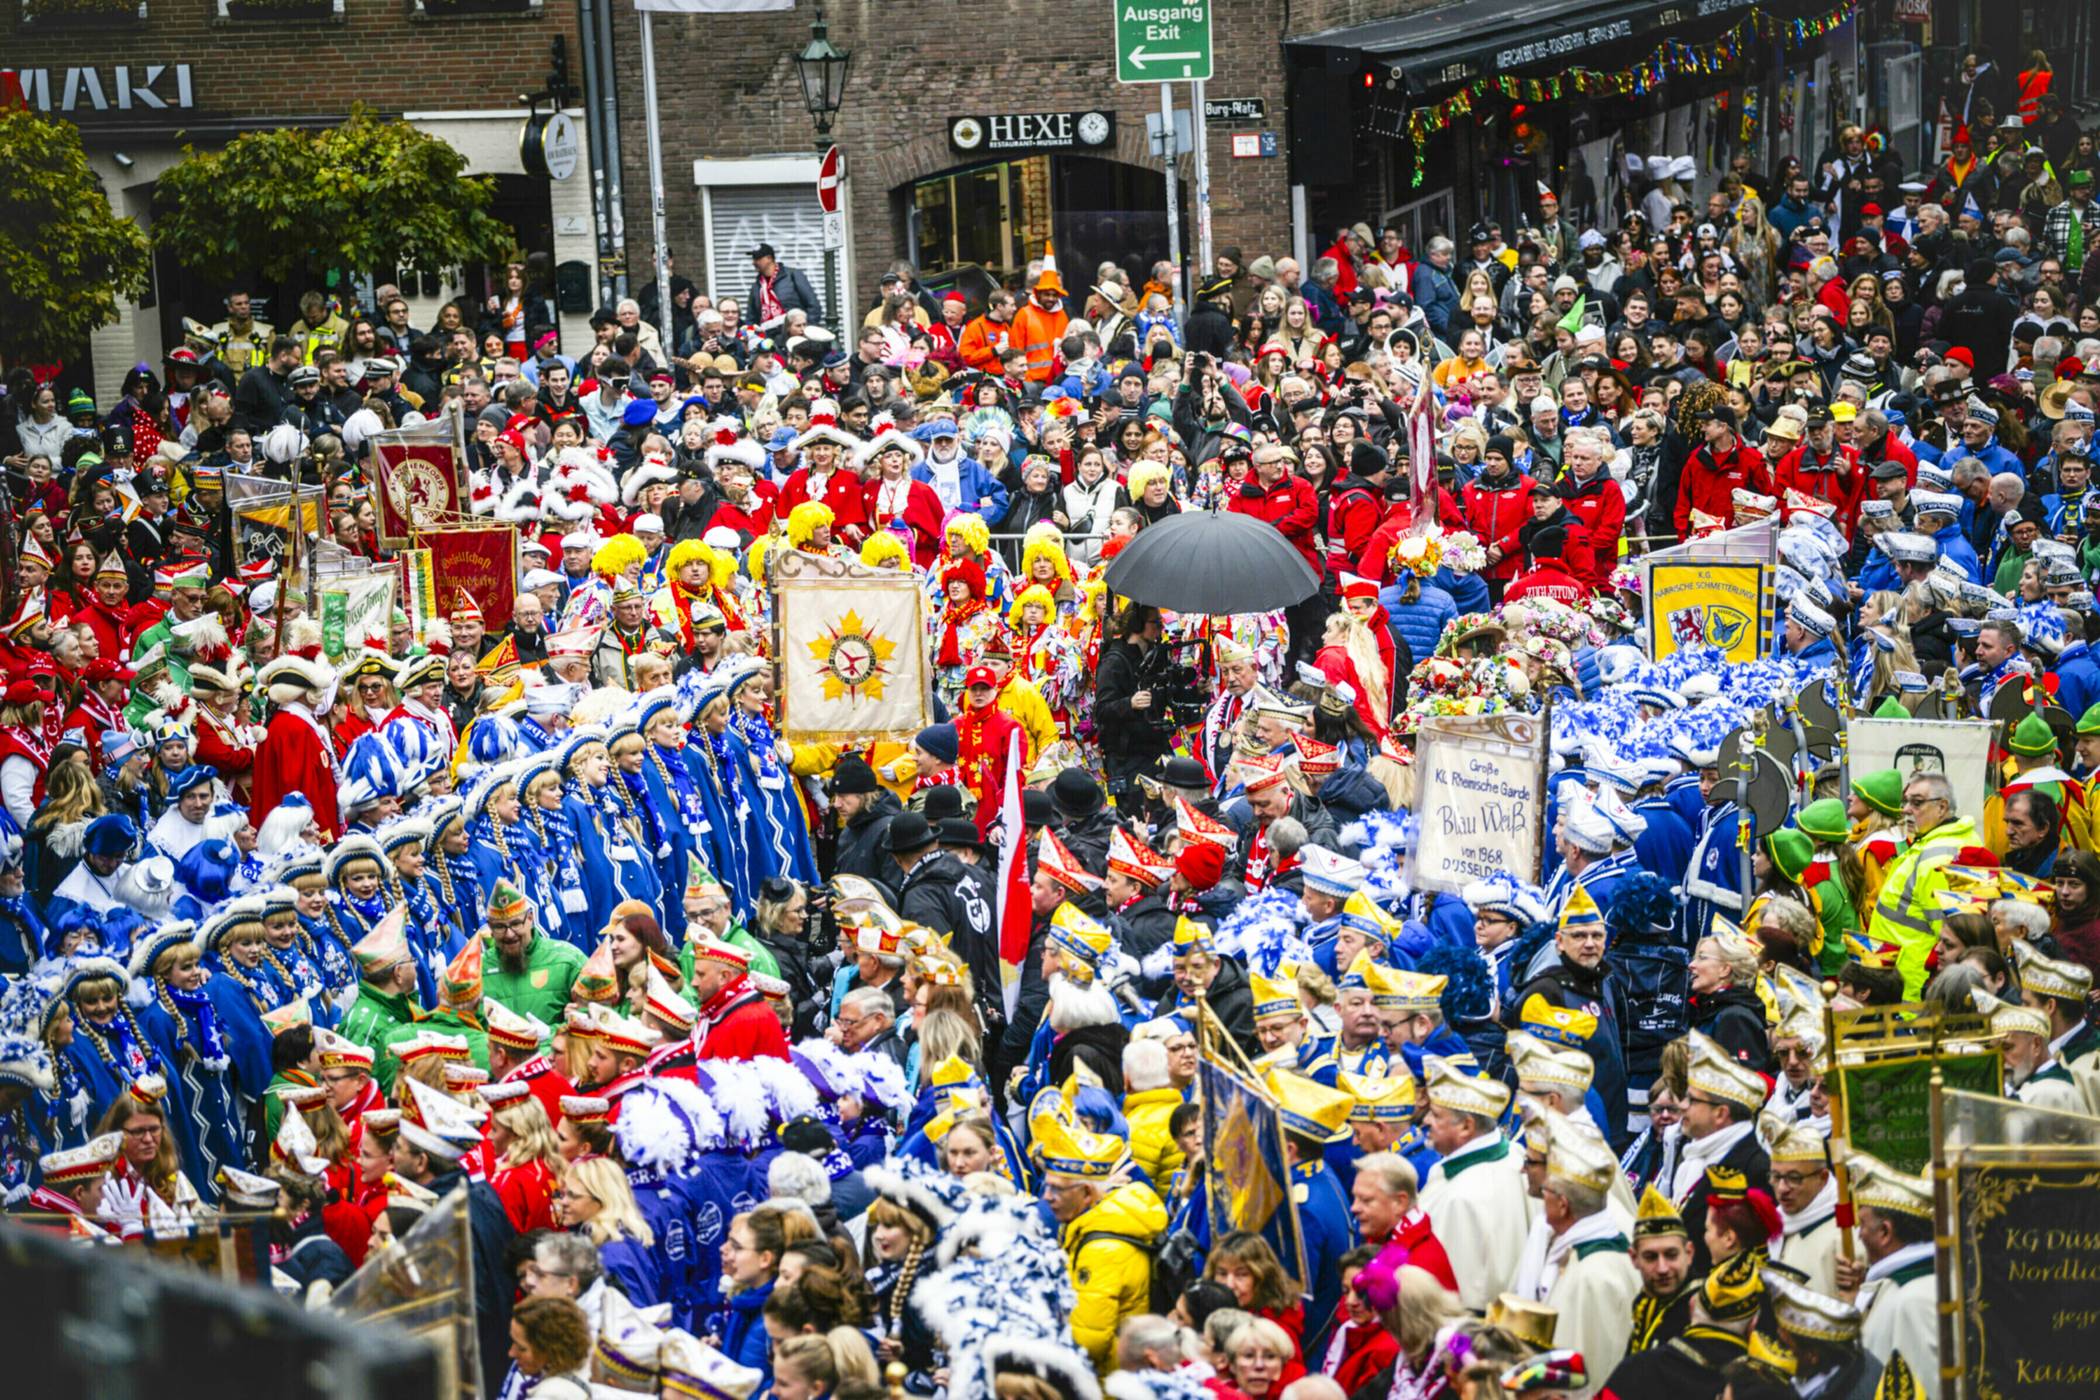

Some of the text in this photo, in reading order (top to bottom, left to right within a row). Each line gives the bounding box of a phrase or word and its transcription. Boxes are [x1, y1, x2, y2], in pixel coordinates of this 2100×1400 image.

[1124, 6, 1203, 24] Ausgang
[1146, 25, 1181, 41] Exit
[1205, 102, 1257, 117] Burg-Platz
[989, 113, 1073, 141] HEXE
[1526, 585, 1579, 601] ZUGLEITUNG
[1469, 758, 1500, 776] Große
[1452, 771, 1500, 794] Rheinische
[1500, 781, 1531, 801] Garde
[1436, 801, 1529, 839] Blau Weiß
[1461, 846, 1503, 865] von 1968
[2006, 1227, 2039, 1253] KG
